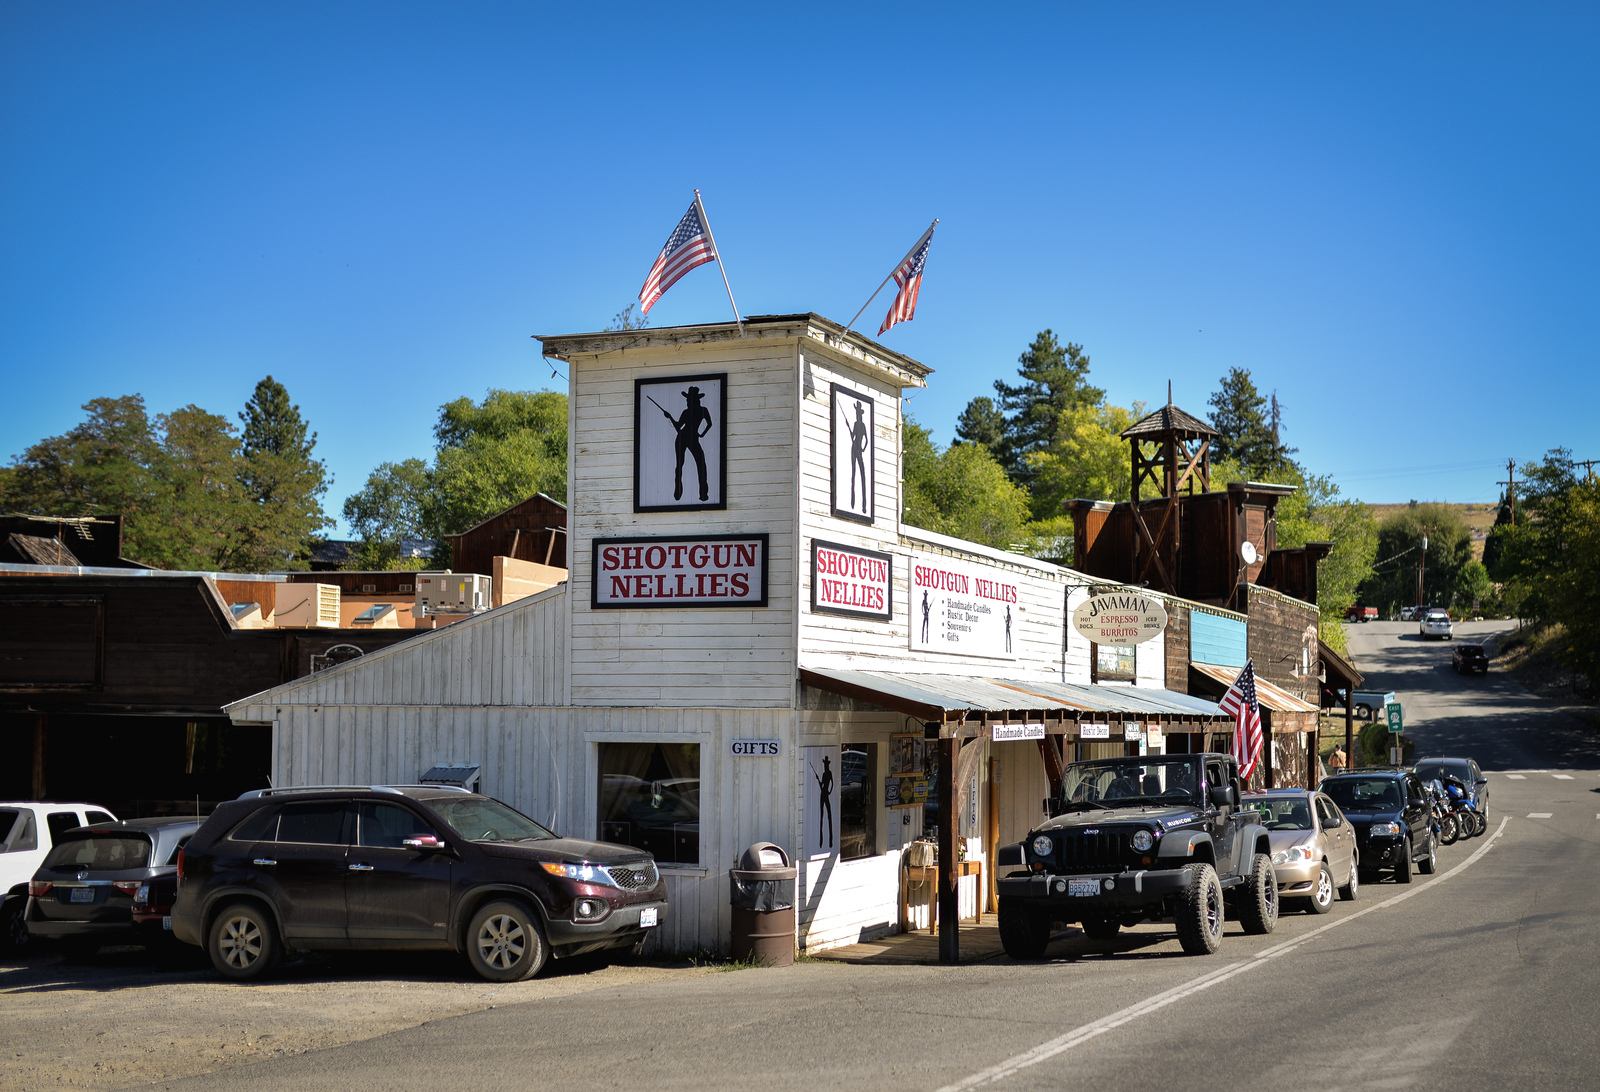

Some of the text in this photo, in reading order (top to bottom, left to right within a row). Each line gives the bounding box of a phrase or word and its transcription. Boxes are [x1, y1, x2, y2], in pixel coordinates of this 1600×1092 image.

[602, 543, 758, 571] SHOTGUN
[816, 548, 887, 584] SHOTGUN
[609, 572, 750, 599] NELLIES
[915, 565, 1017, 604] SHOTGUN NELLIES
[820, 578, 884, 610] NELLIES
[947, 597, 992, 615] Handmade Candles
[1089, 596, 1150, 617] JAVAMAN
[947, 608, 979, 623] Rustic Decor
[1100, 615, 1139, 624] ESPRESSO
[946, 631, 960, 642] Gifts
[1100, 628, 1138, 637] BURRITOS
[994, 725, 1044, 739] Handmade Candles
[1082, 725, 1108, 736] Rustic Decor
[731, 742, 778, 755] GIFTS
[1166, 817, 1192, 828] RUBICON
[1083, 828, 1100, 836] Jeep
